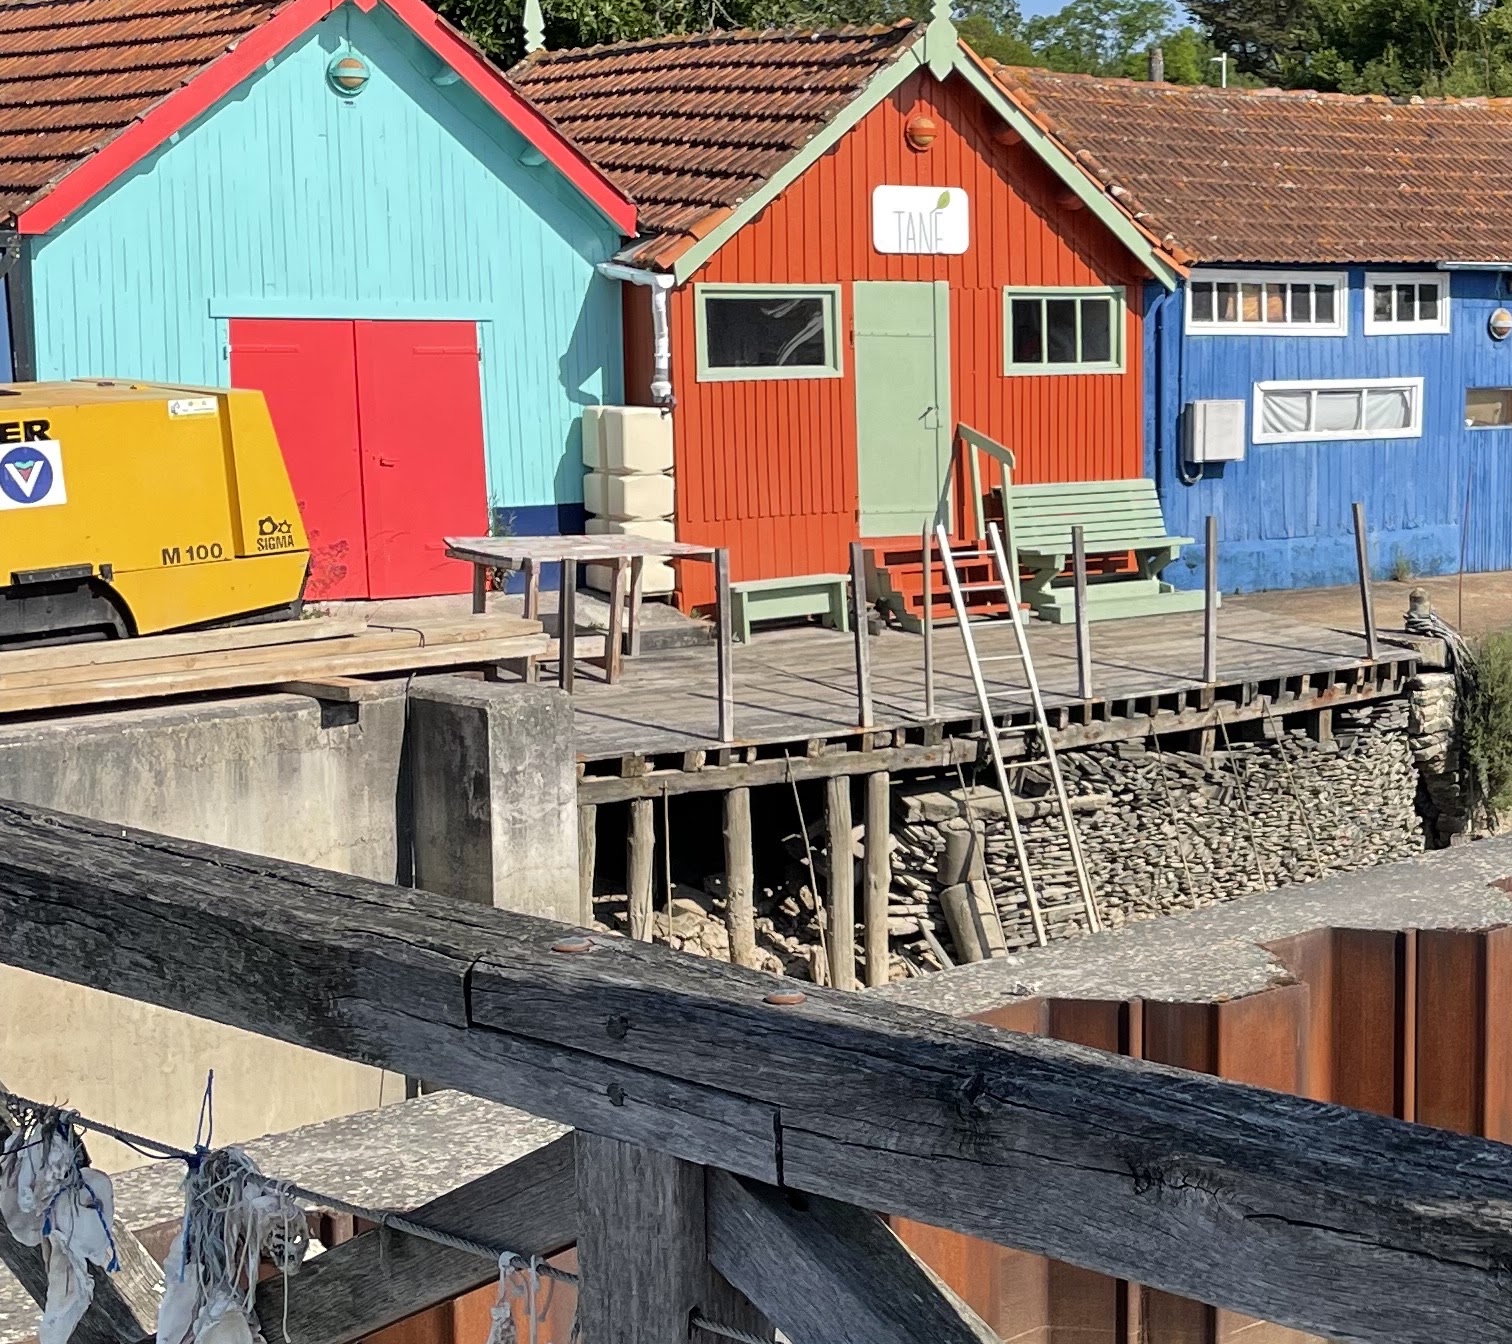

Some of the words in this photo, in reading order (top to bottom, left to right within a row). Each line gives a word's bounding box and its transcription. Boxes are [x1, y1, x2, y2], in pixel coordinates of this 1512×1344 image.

[256, 534, 295, 552] SIGMA
[161, 547, 181, 565] M
[185, 543, 223, 561] 100
